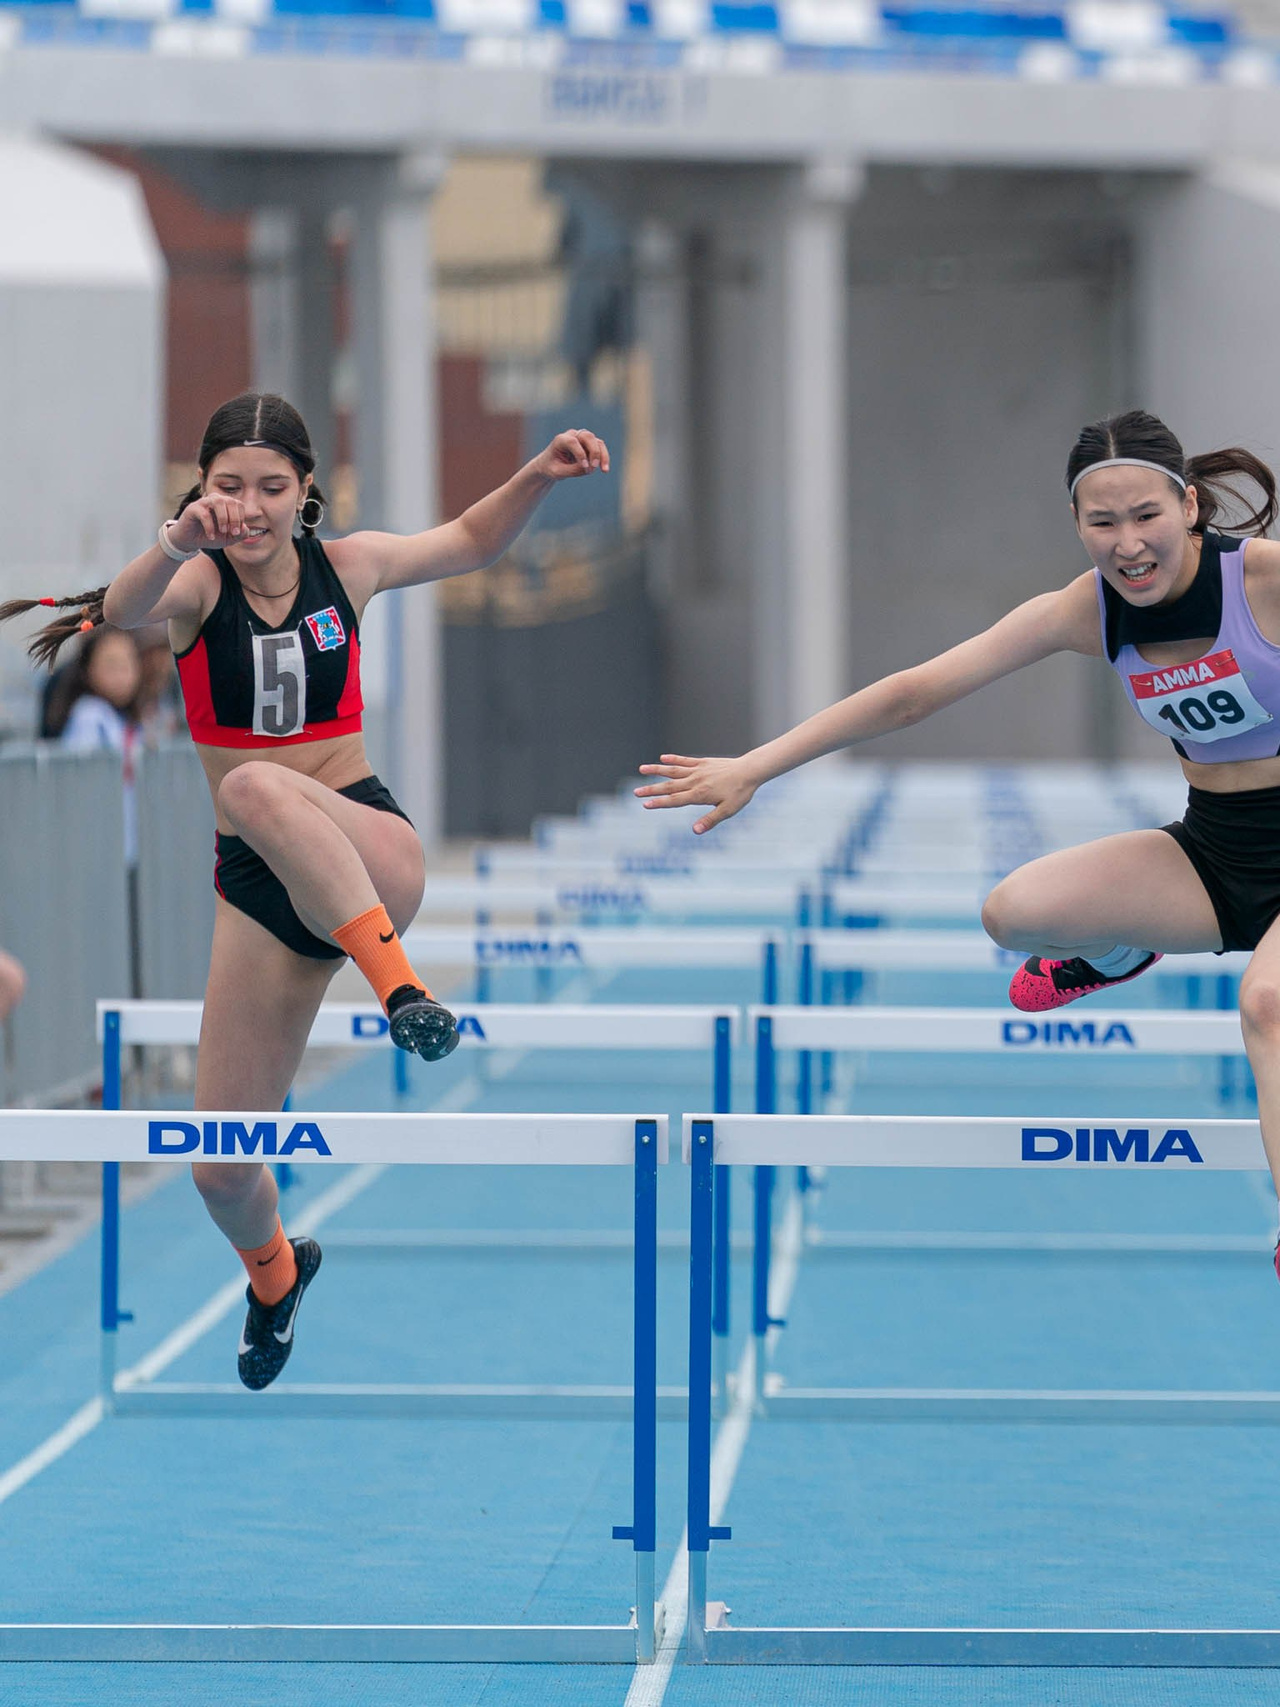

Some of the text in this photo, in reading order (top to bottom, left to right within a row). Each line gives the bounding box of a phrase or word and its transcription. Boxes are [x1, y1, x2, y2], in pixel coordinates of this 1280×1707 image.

[261, 636, 298, 735] 5
[1153, 662, 1215, 693] AMMA
[1158, 690, 1245, 734] 109
[352, 1015, 487, 1040] DA
[1003, 1021, 1136, 1046] DIMA
[148, 1121, 332, 1156] DIMA
[1021, 1128, 1204, 1163] DIMA
